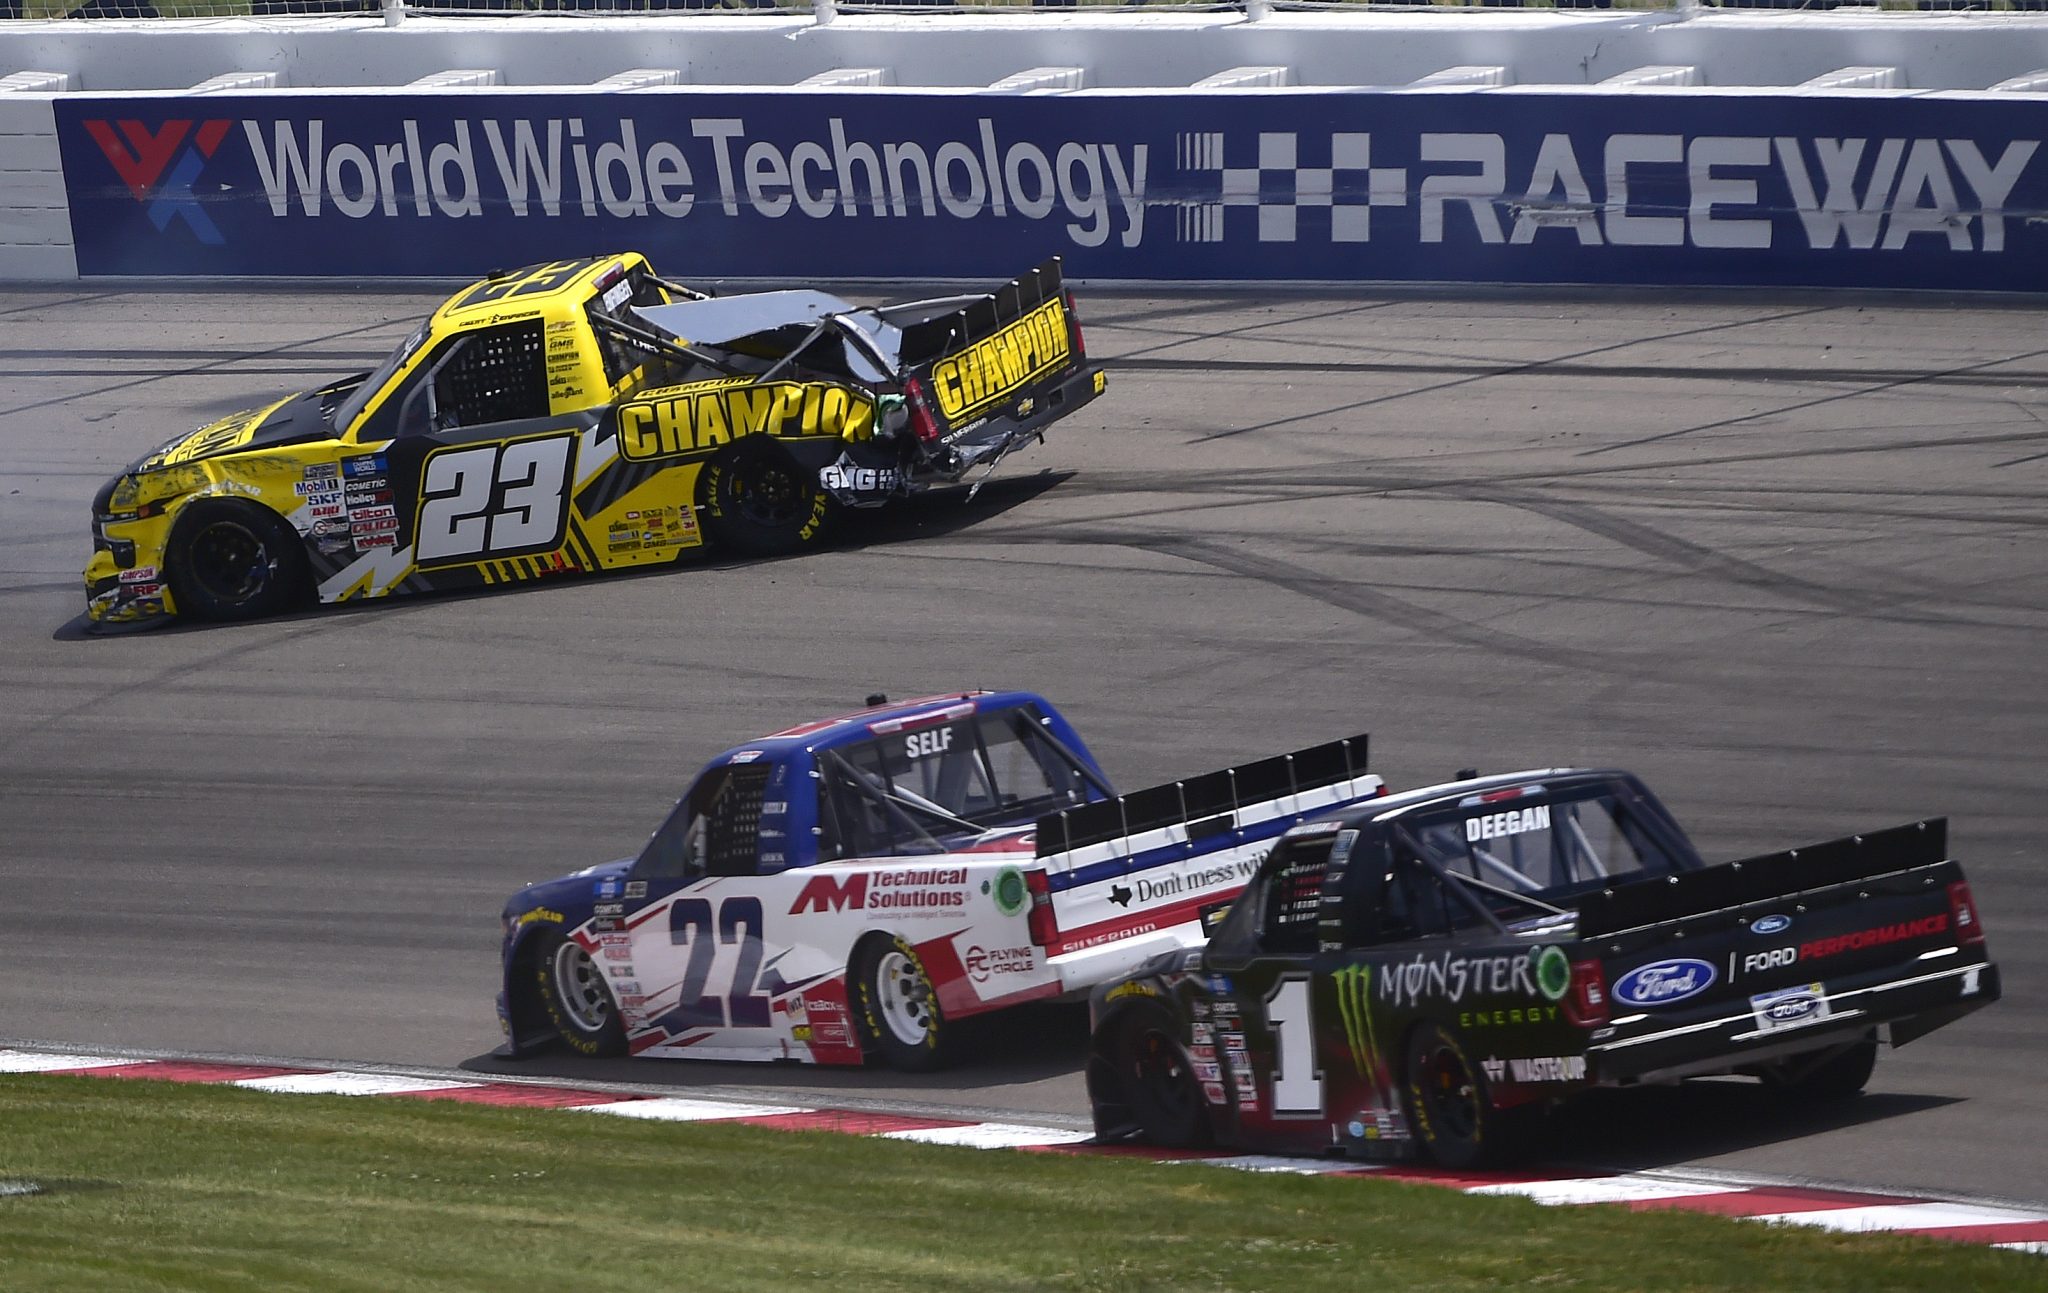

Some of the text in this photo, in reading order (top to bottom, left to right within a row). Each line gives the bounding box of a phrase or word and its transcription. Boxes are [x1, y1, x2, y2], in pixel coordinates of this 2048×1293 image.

[242, 117, 2041, 253] World Wide Technology RACEWAY
[935, 302, 1069, 414] CHAMPION
[551, 387, 584, 399] allegiant
[623, 384, 873, 458] CHAMPION
[354, 464, 377, 472] WORLD
[295, 481, 327, 494] Mobil
[346, 479, 387, 491] COMETIC
[308, 493, 342, 506] SKF
[347, 494, 376, 505] Holley
[416, 436, 571, 561] 23
[351, 508, 393, 520] tilton
[120, 568, 154, 580] SIMPSON
[905, 727, 953, 759] SELF
[1466, 805, 1551, 842] DEEGAN
[872, 867, 968, 888] Technical
[1137, 872, 1183, 903] Don't
[1187, 864, 1235, 890] mess
[868, 889, 964, 909] Solutions
[1743, 912, 1949, 973] FORD PERFORMANCE
[669, 896, 772, 1029] 22
[989, 946, 1032, 961] FLYING
[993, 960, 1035, 975] CIRCLE
[1960, 968, 1980, 996] 1
[1459, 1006, 1558, 1027] ENERGY
[1266, 975, 1325, 1117] 1
